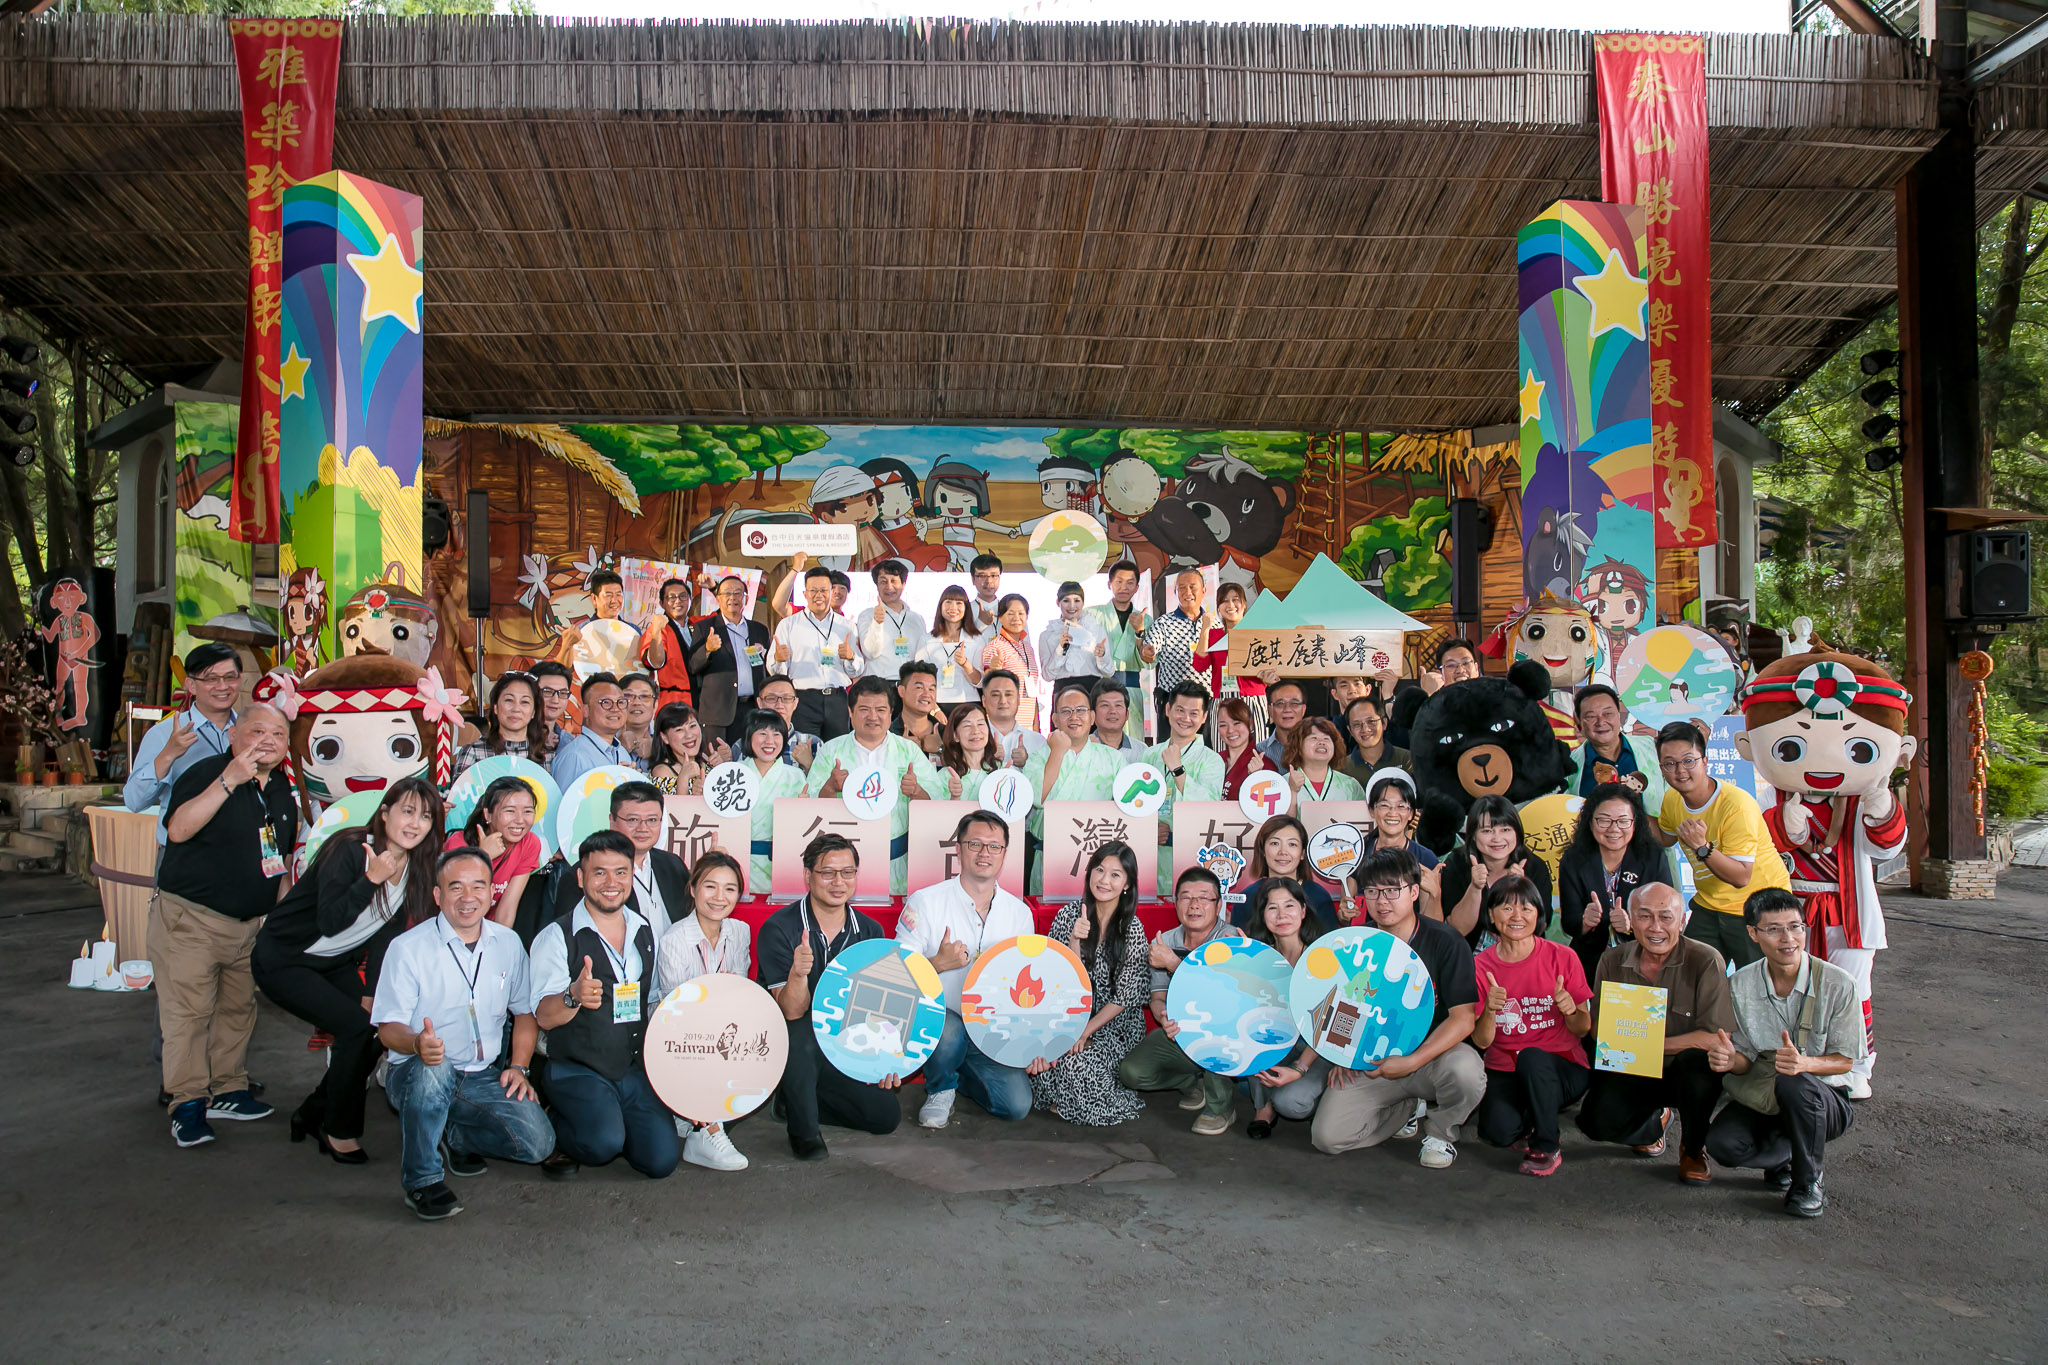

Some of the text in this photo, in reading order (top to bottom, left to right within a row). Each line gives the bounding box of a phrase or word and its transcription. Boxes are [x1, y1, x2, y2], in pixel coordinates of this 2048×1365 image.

[1706, 748, 1741, 761] 熊出沒
[664, 1040, 716, 1054] Taiwan
